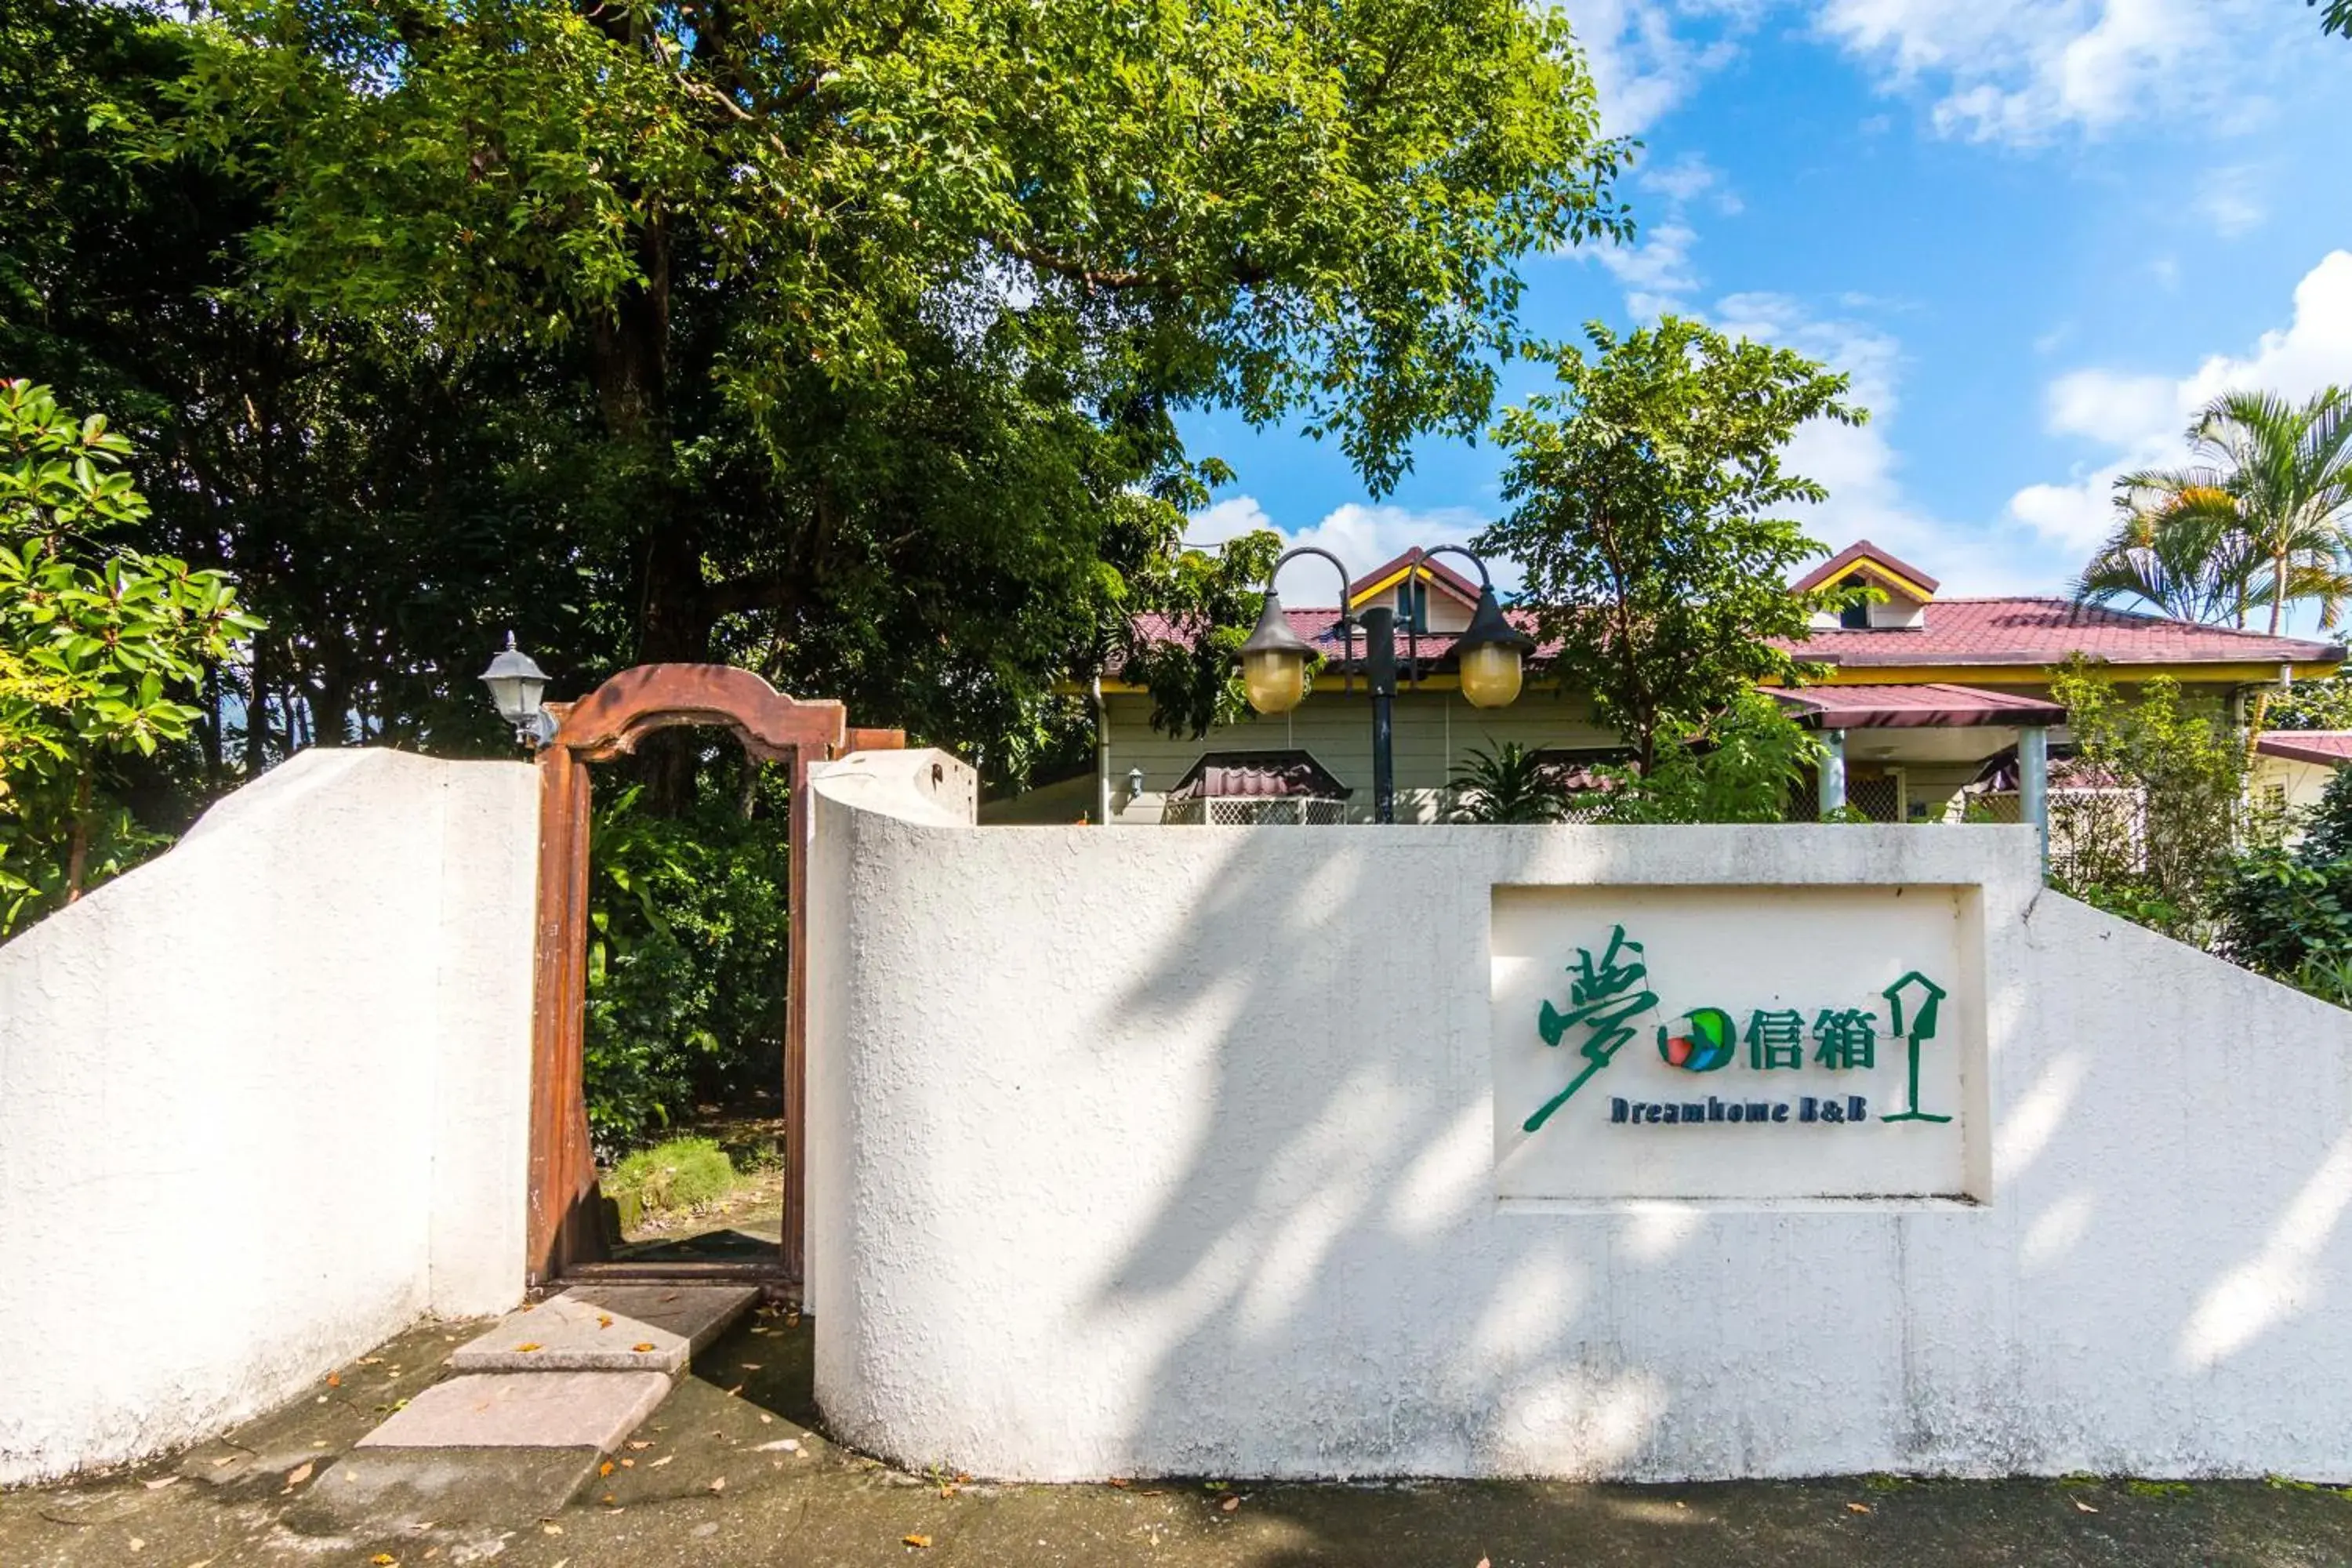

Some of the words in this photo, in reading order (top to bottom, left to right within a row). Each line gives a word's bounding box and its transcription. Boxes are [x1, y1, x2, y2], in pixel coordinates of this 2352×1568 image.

[1743, 1008, 1878, 1070] 信箱
[1610, 1095, 1790, 1124] Dreamhome
[1798, 1095, 1867, 1124] B&B
